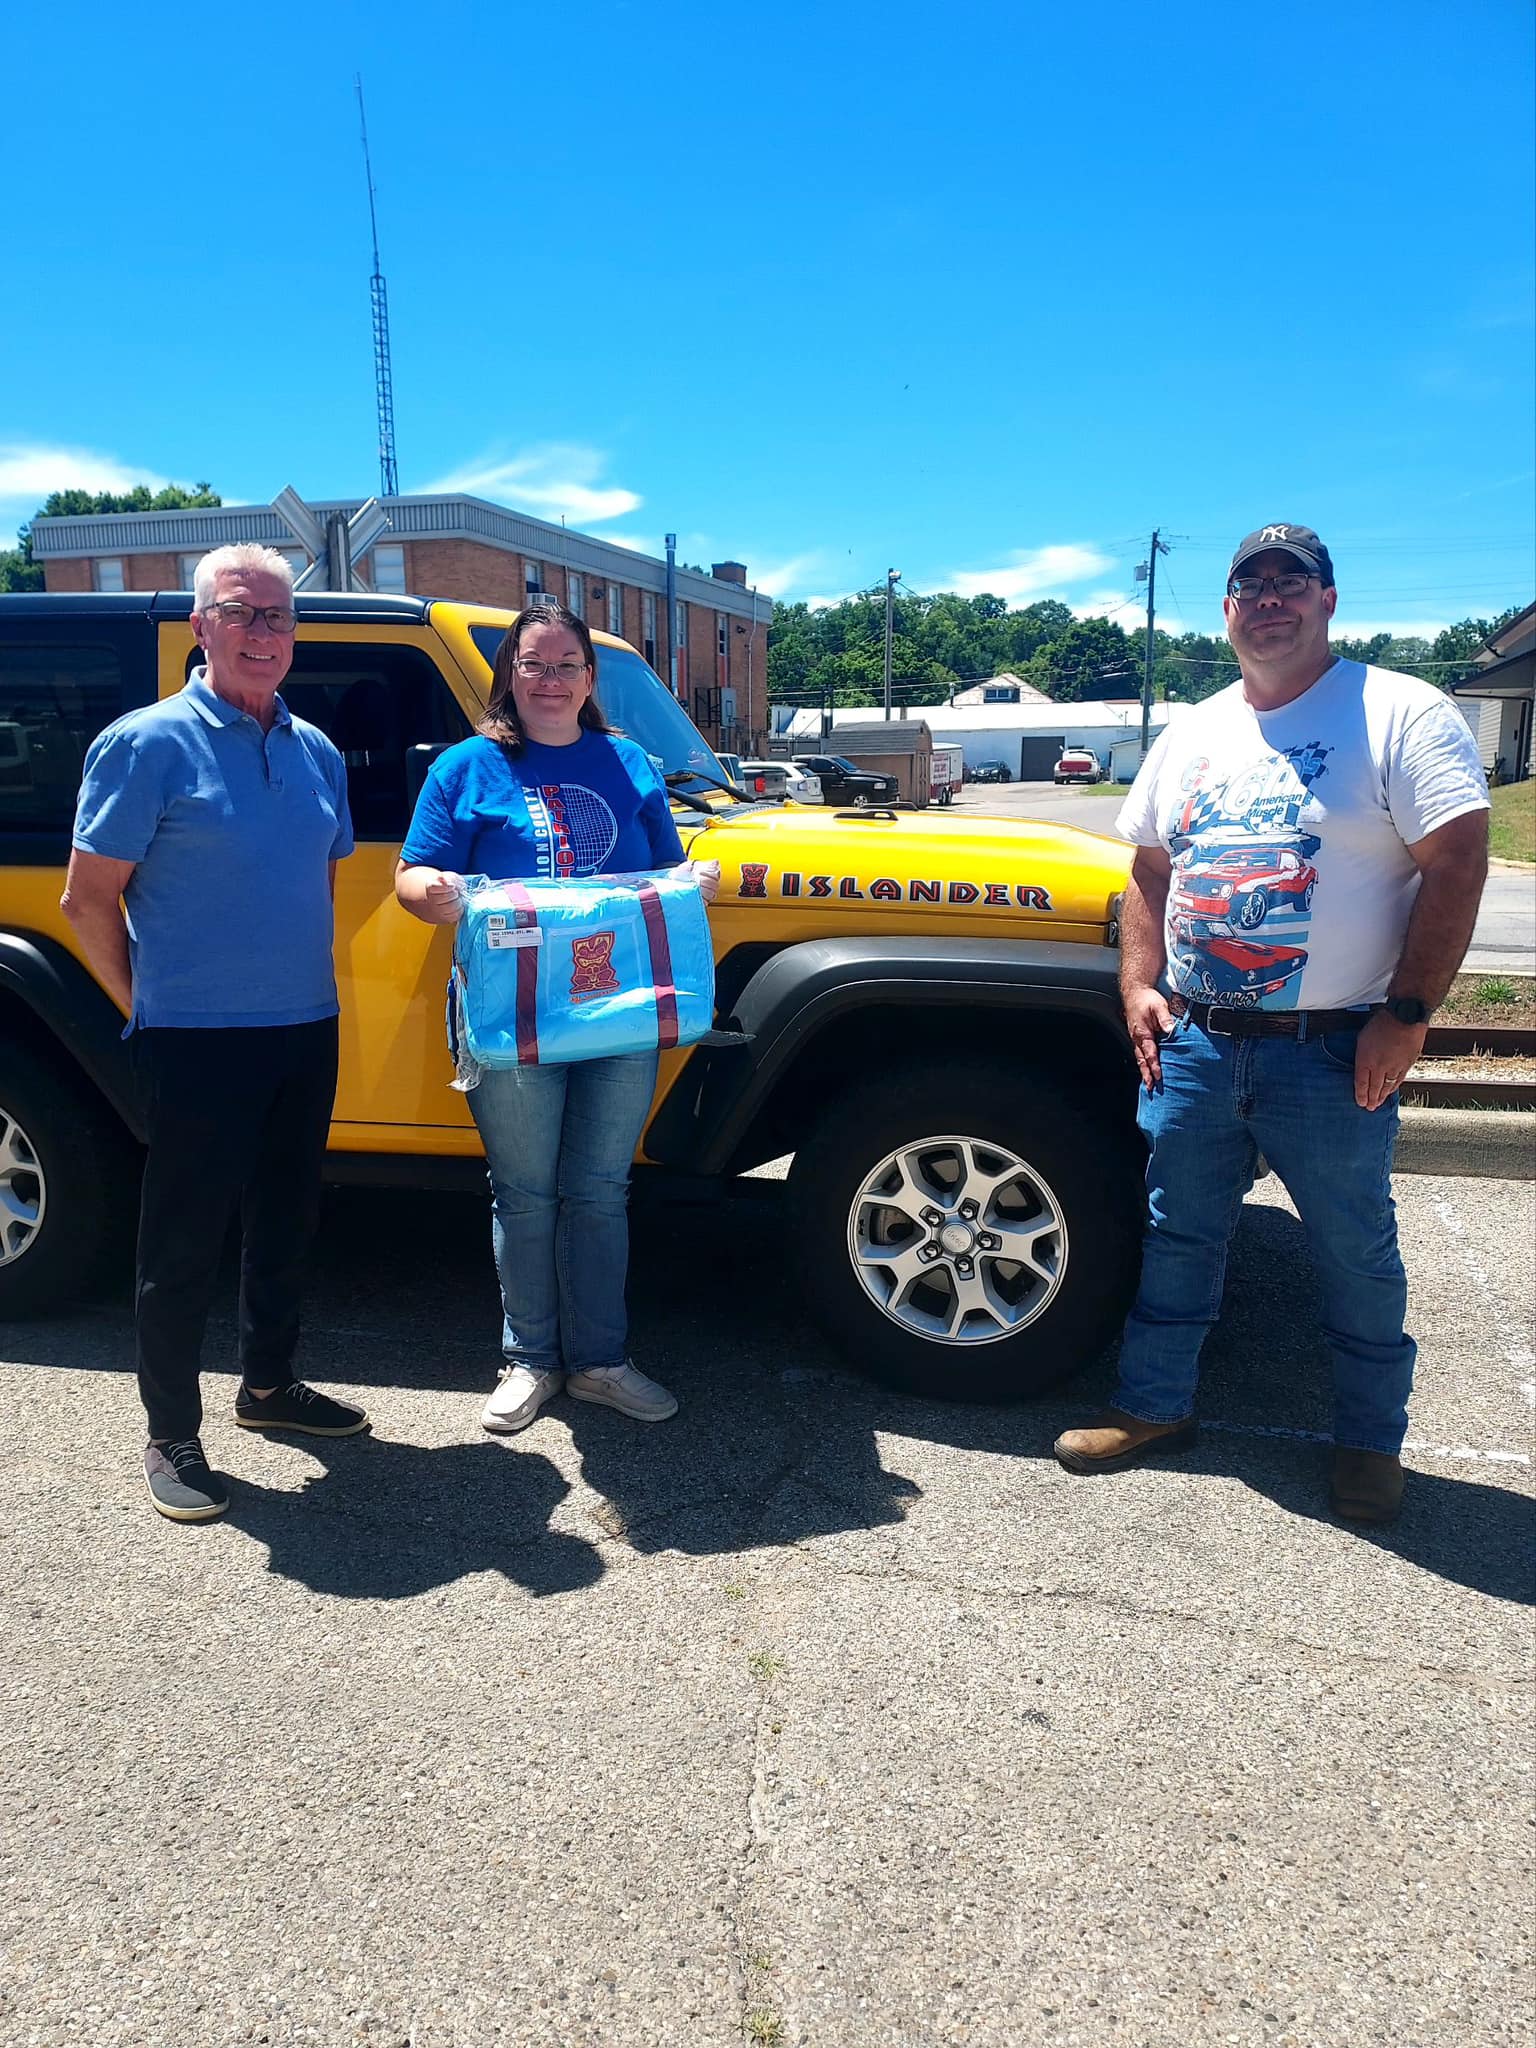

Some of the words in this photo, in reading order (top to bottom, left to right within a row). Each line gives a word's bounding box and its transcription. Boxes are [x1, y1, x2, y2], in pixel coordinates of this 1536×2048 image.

[522, 786, 549, 838] COUNTY
[1246, 804, 1285, 819] Muscle
[1251, 793, 1303, 809] American
[536, 843, 552, 879] ION
[780, 871, 1055, 911] ISLANDER
